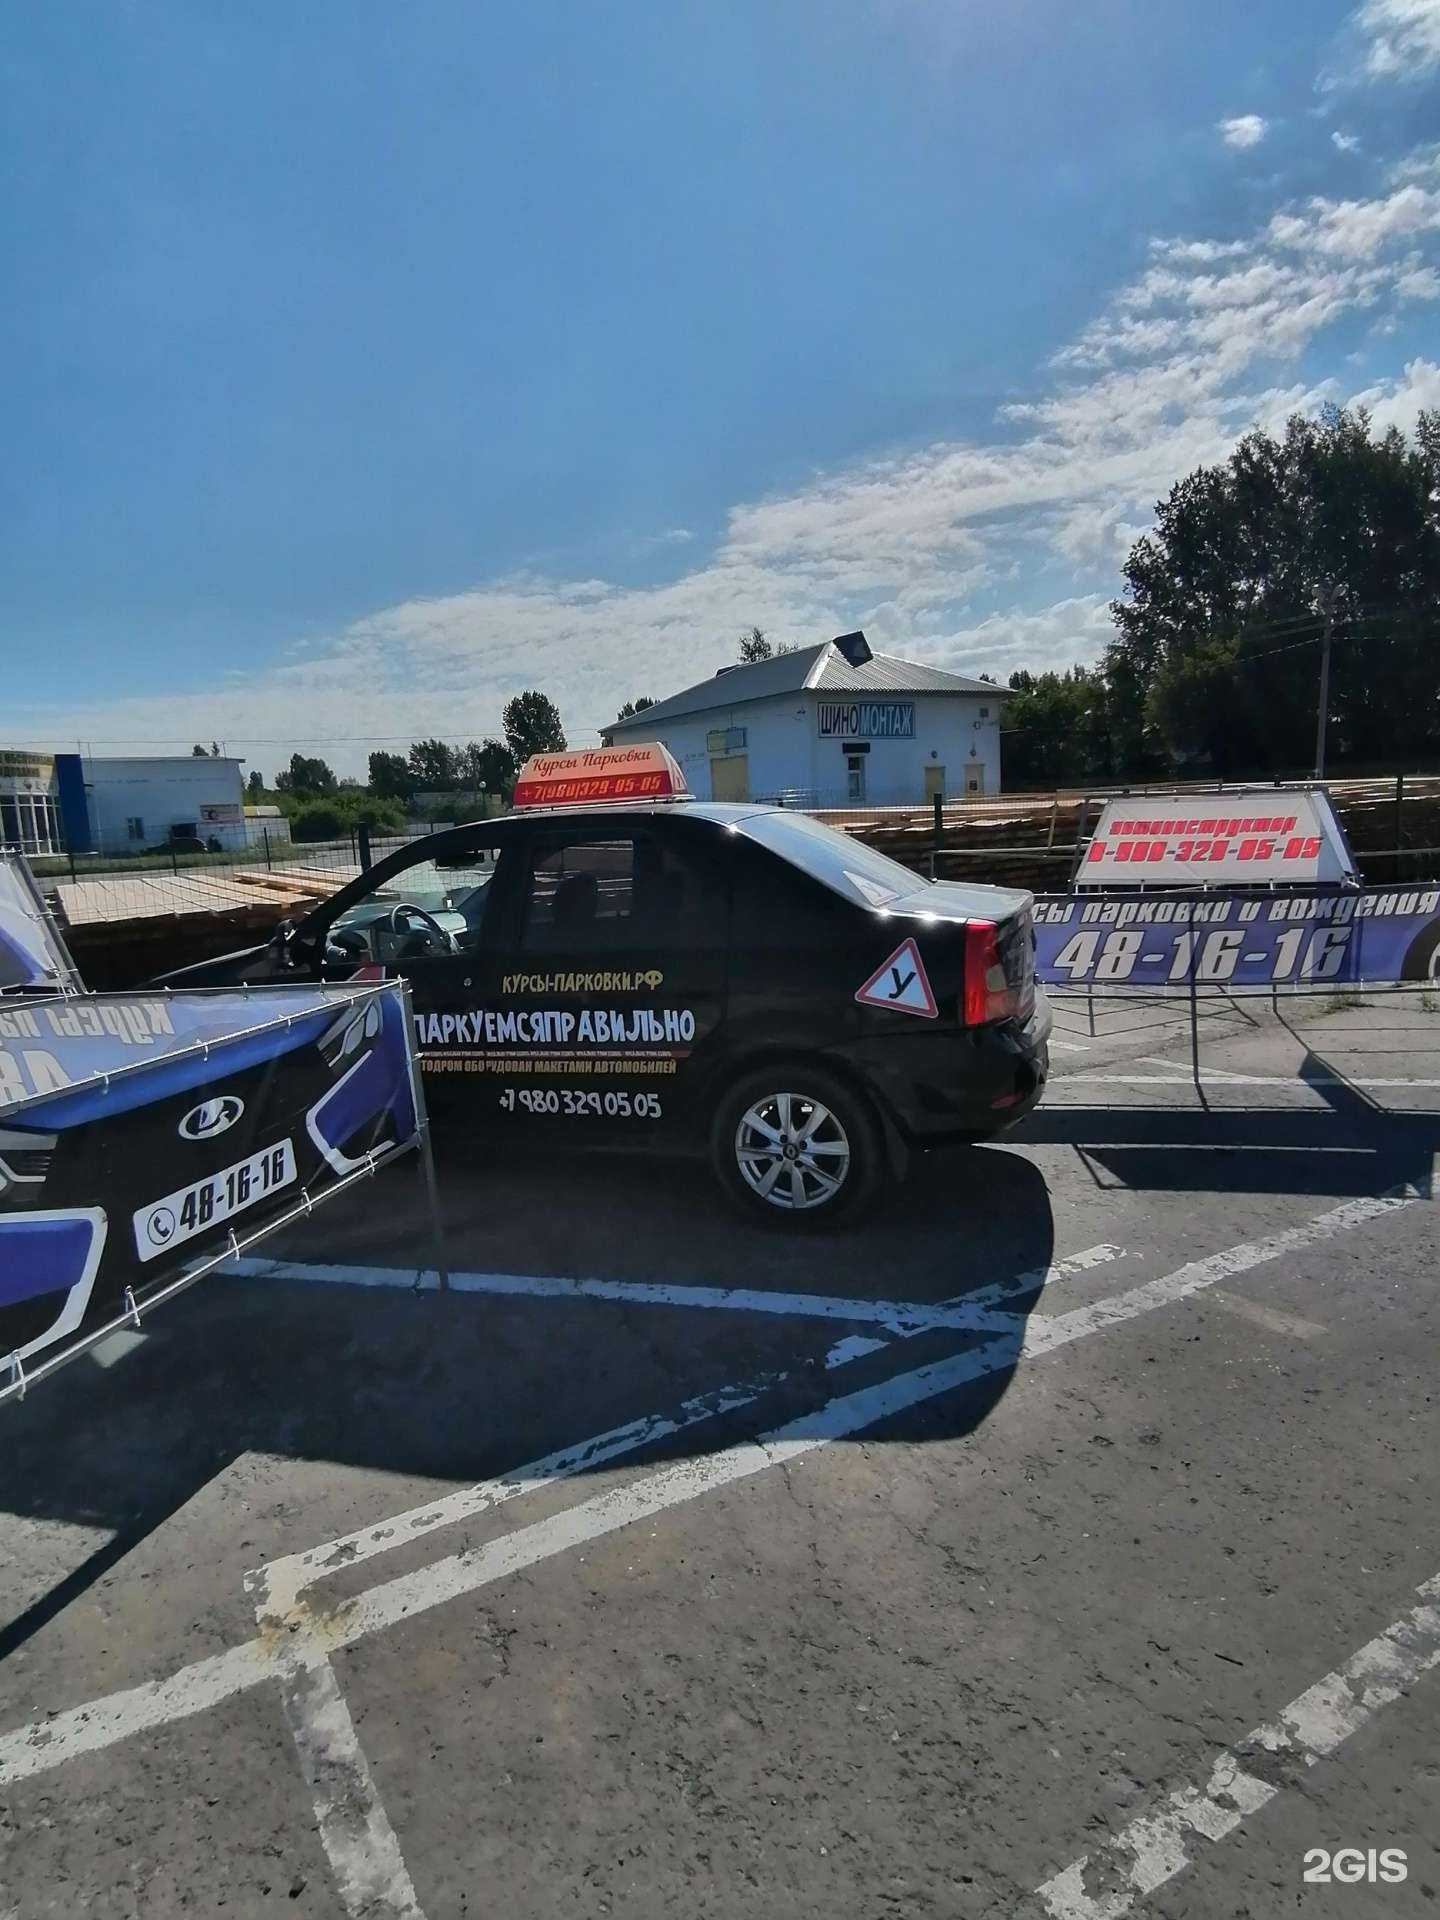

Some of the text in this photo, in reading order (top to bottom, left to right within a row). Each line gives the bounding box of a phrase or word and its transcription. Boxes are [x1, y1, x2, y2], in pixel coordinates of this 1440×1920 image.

[821, 704, 912, 735] ШИНОМОНТАЖ
[532, 749, 652, 777] Курсы Парковки
[1081, 900, 1232, 929] парковки
[1268, 891, 1440, 925] вождения
[1053, 926, 1352, 981] 48-16-16
[502, 970, 664, 993] КУРСЫ-ПАРКОВКИ.РФ
[464, 1060, 532, 1073] ОБОРУДОВАН
[534, 1060, 592, 1073] МАКЕТАМИ
[594, 1059, 677, 1075] АВТОМОБИЛЕЙ
[180, 1147, 285, 1231] 48-16-16
